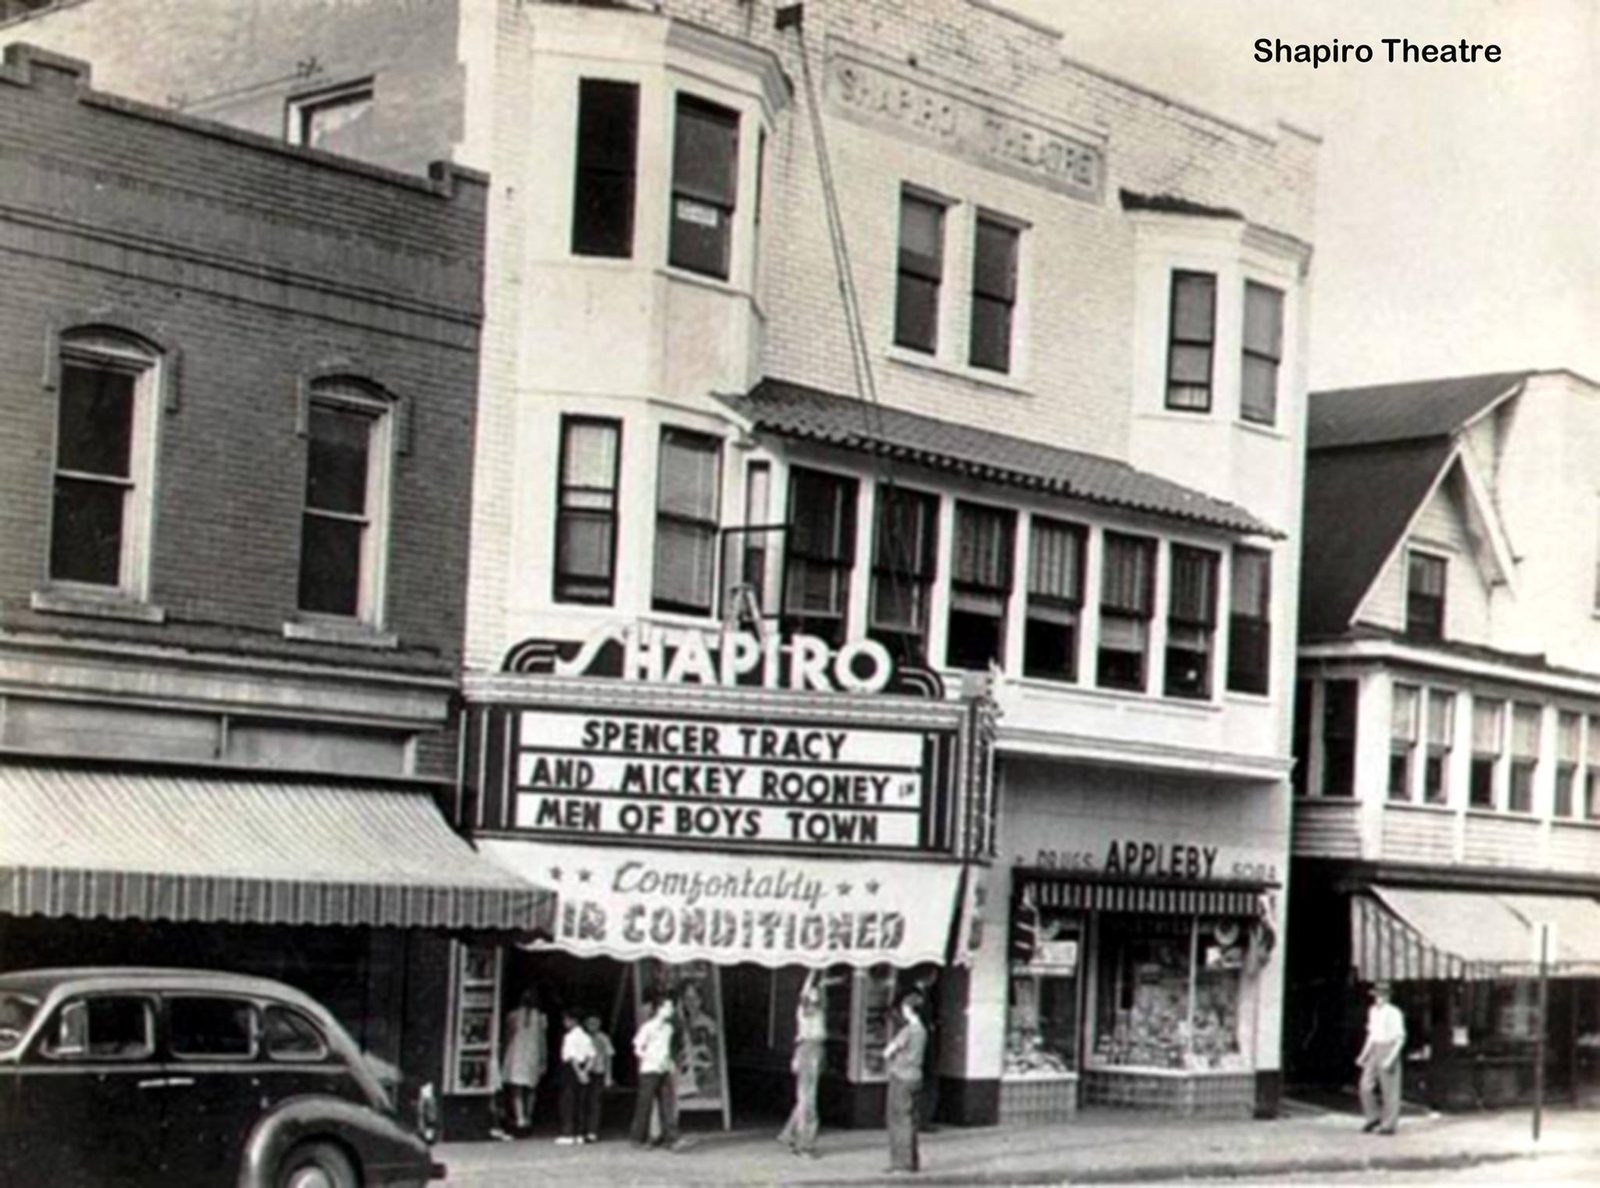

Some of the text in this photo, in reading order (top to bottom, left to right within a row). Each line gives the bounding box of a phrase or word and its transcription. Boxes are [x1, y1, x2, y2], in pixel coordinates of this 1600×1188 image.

[983, 117, 1094, 186] THEATRE
[553, 622, 892, 693] SHAPIRO
[582, 720, 847, 760] SPENCER TRACY
[531, 758, 594, 788] AND
[621, 764, 746, 795] MICKEY
[761, 770, 890, 803] ROONEY
[536, 798, 879, 843] MEN OF BOYS TOWN
[1105, 839, 1218, 878] APPLEBY
[612, 862, 825, 908] Comfortably
[562, 901, 905, 950] IR CONDITIONED
